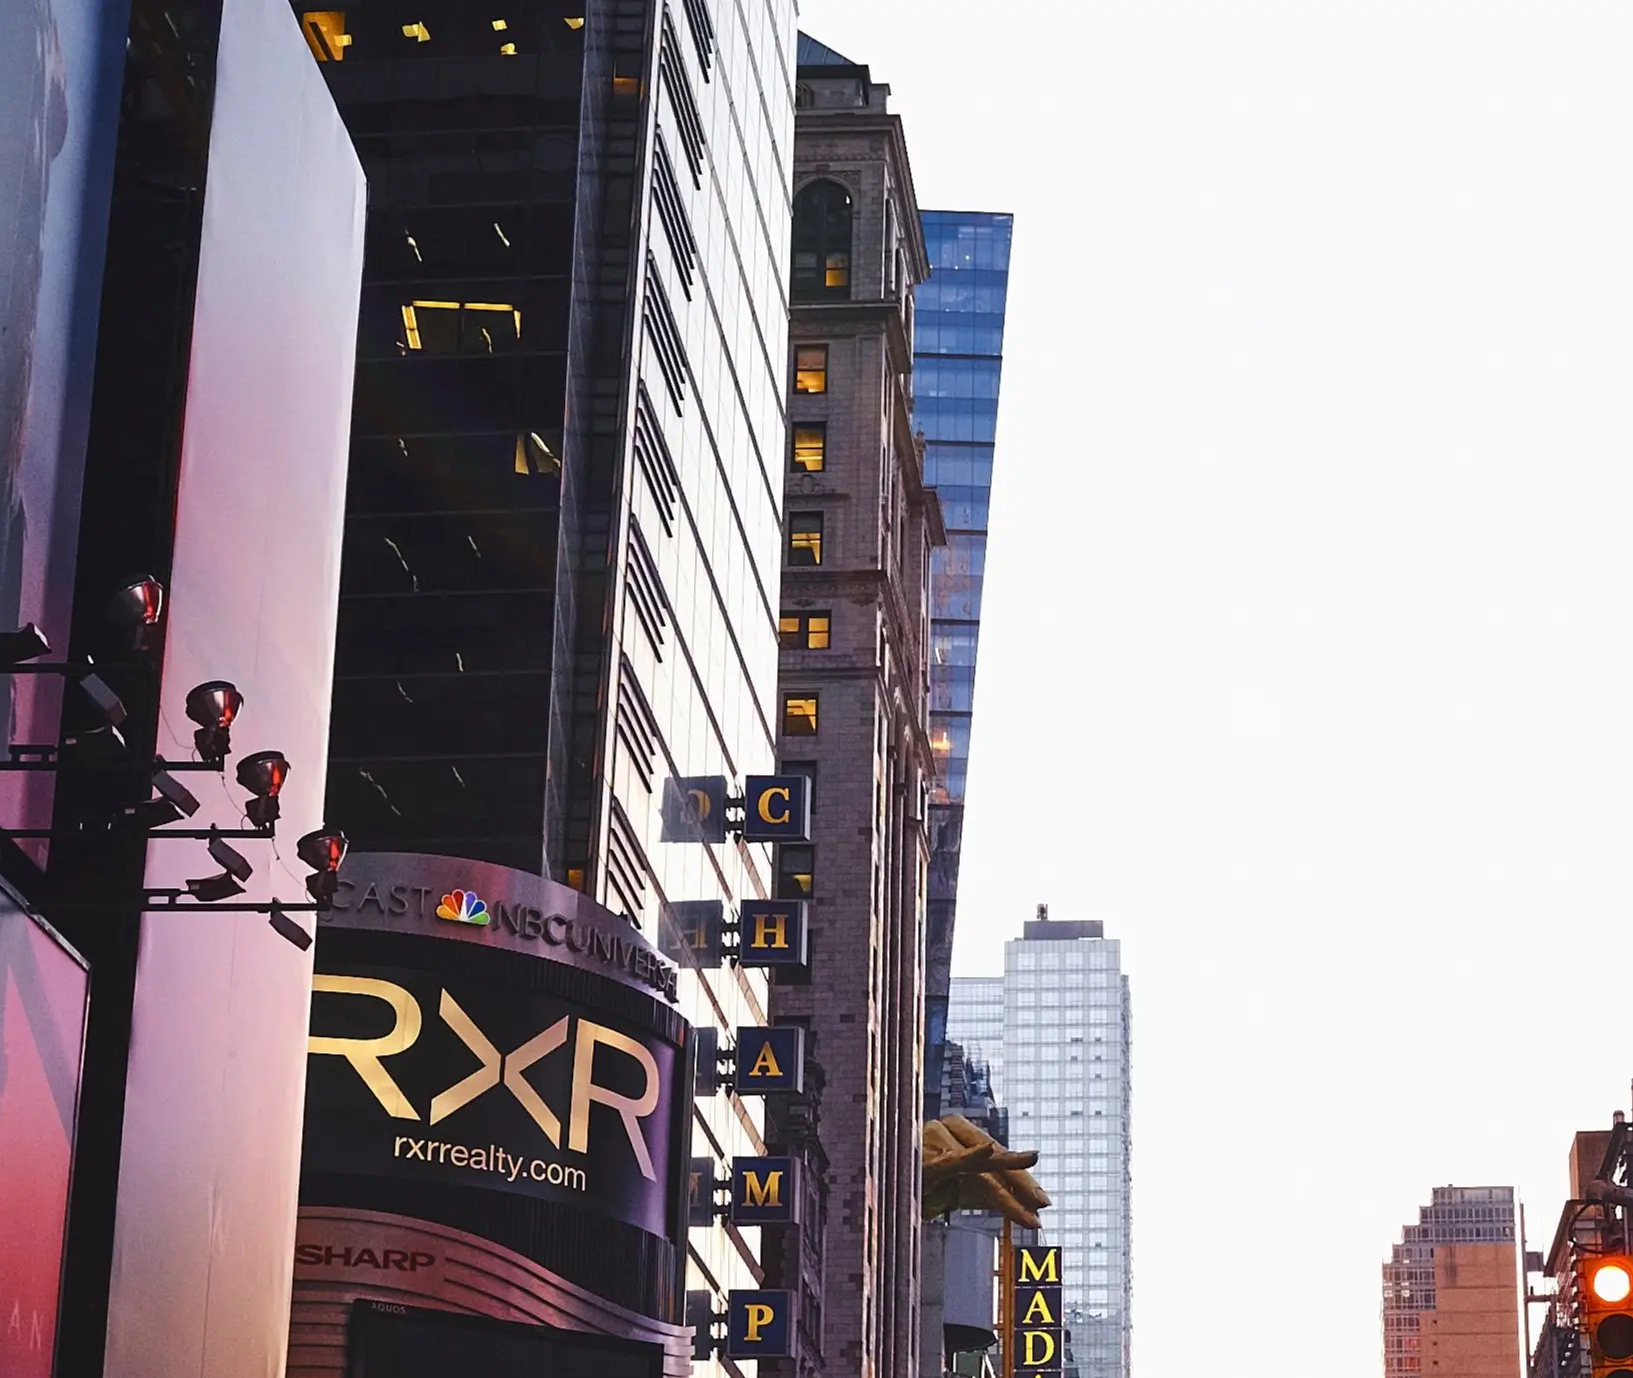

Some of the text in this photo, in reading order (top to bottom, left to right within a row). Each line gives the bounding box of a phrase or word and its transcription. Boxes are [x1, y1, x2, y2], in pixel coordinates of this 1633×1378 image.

[393, 1133, 587, 1192] rxrrealty.com
[296, 1243, 436, 1274] SHARP
[371, 1301, 407, 1316] AQUOS
